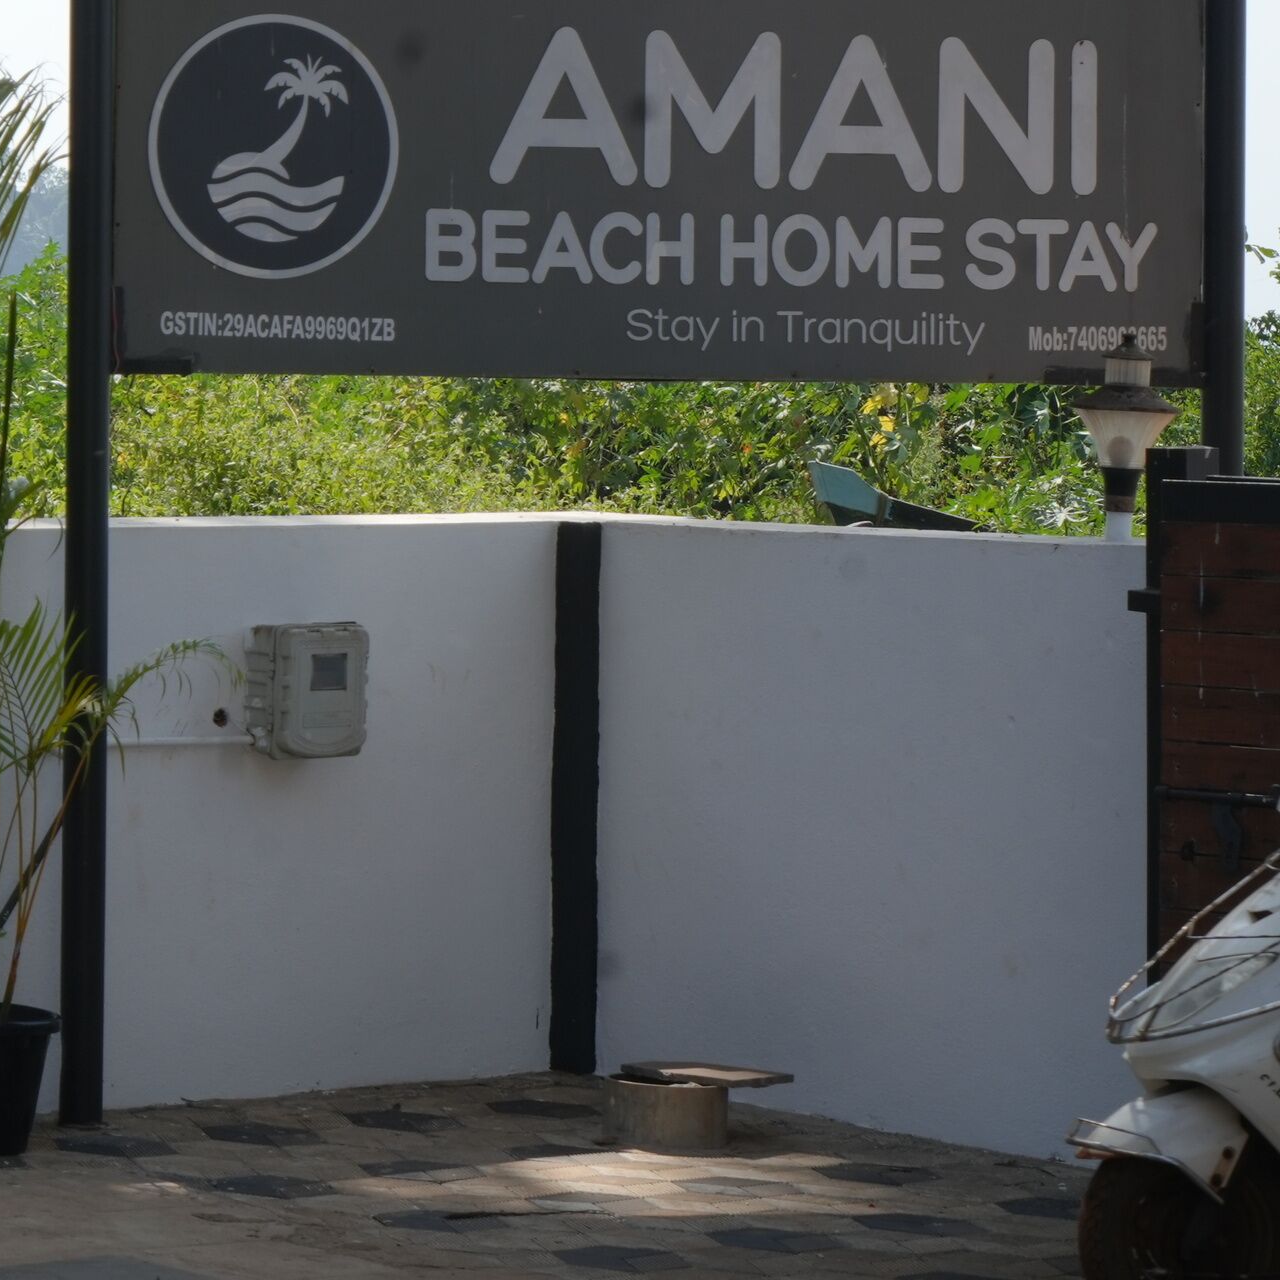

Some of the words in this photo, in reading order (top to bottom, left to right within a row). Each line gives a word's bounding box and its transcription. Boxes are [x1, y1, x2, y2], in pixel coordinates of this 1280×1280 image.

[489, 26, 1098, 196] AMANI
[425, 208, 695, 286] BEACH
[720, 213, 945, 290] HOME
[965, 218, 1158, 293] STAY
[159, 310, 397, 342] GSTIN:29ACAFA9969Q1ZB
[626, 308, 720, 351] Stay
[732, 310, 765, 342] in
[776, 311, 986, 356] Tranquility
